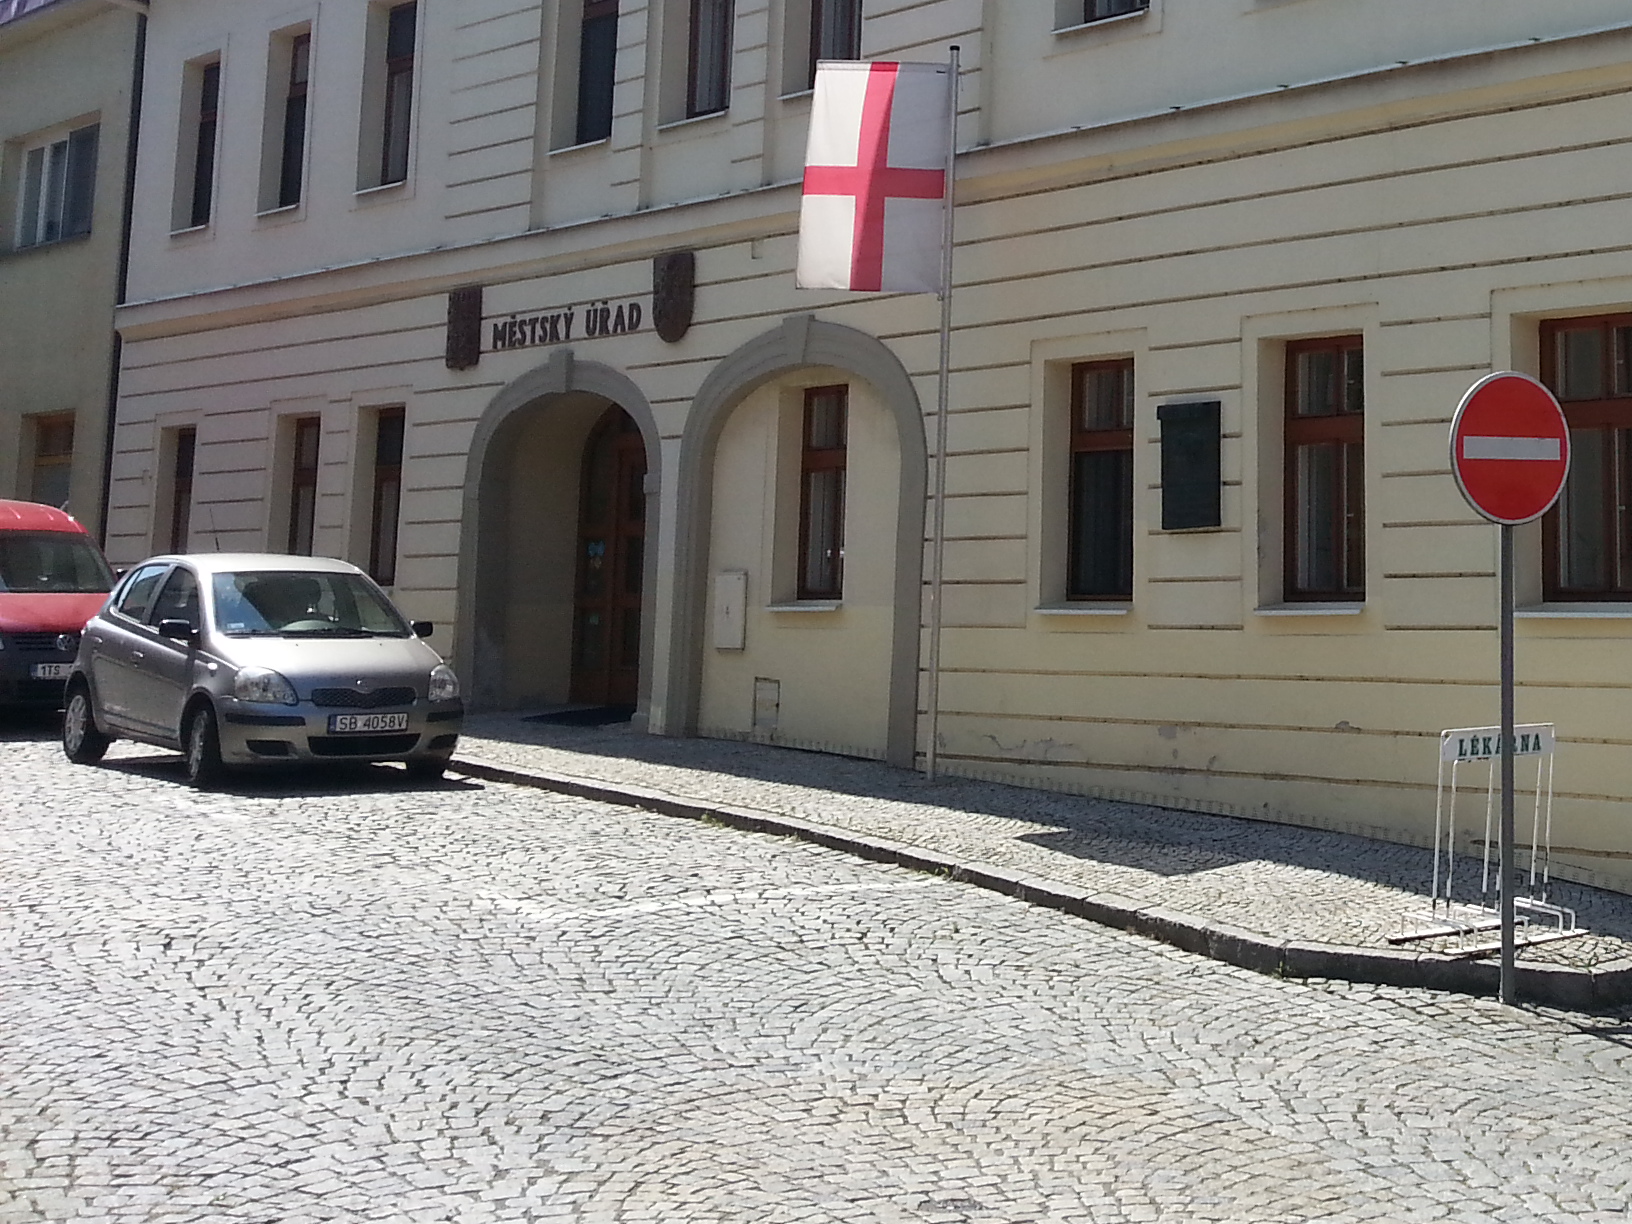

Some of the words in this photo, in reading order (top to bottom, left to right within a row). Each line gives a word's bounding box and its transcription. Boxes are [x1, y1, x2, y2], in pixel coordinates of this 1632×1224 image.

[492, 306, 574, 349] MĚSTSKÝ
[585, 301, 642, 337] ÚŘAD
[339, 716, 357, 731] SB
